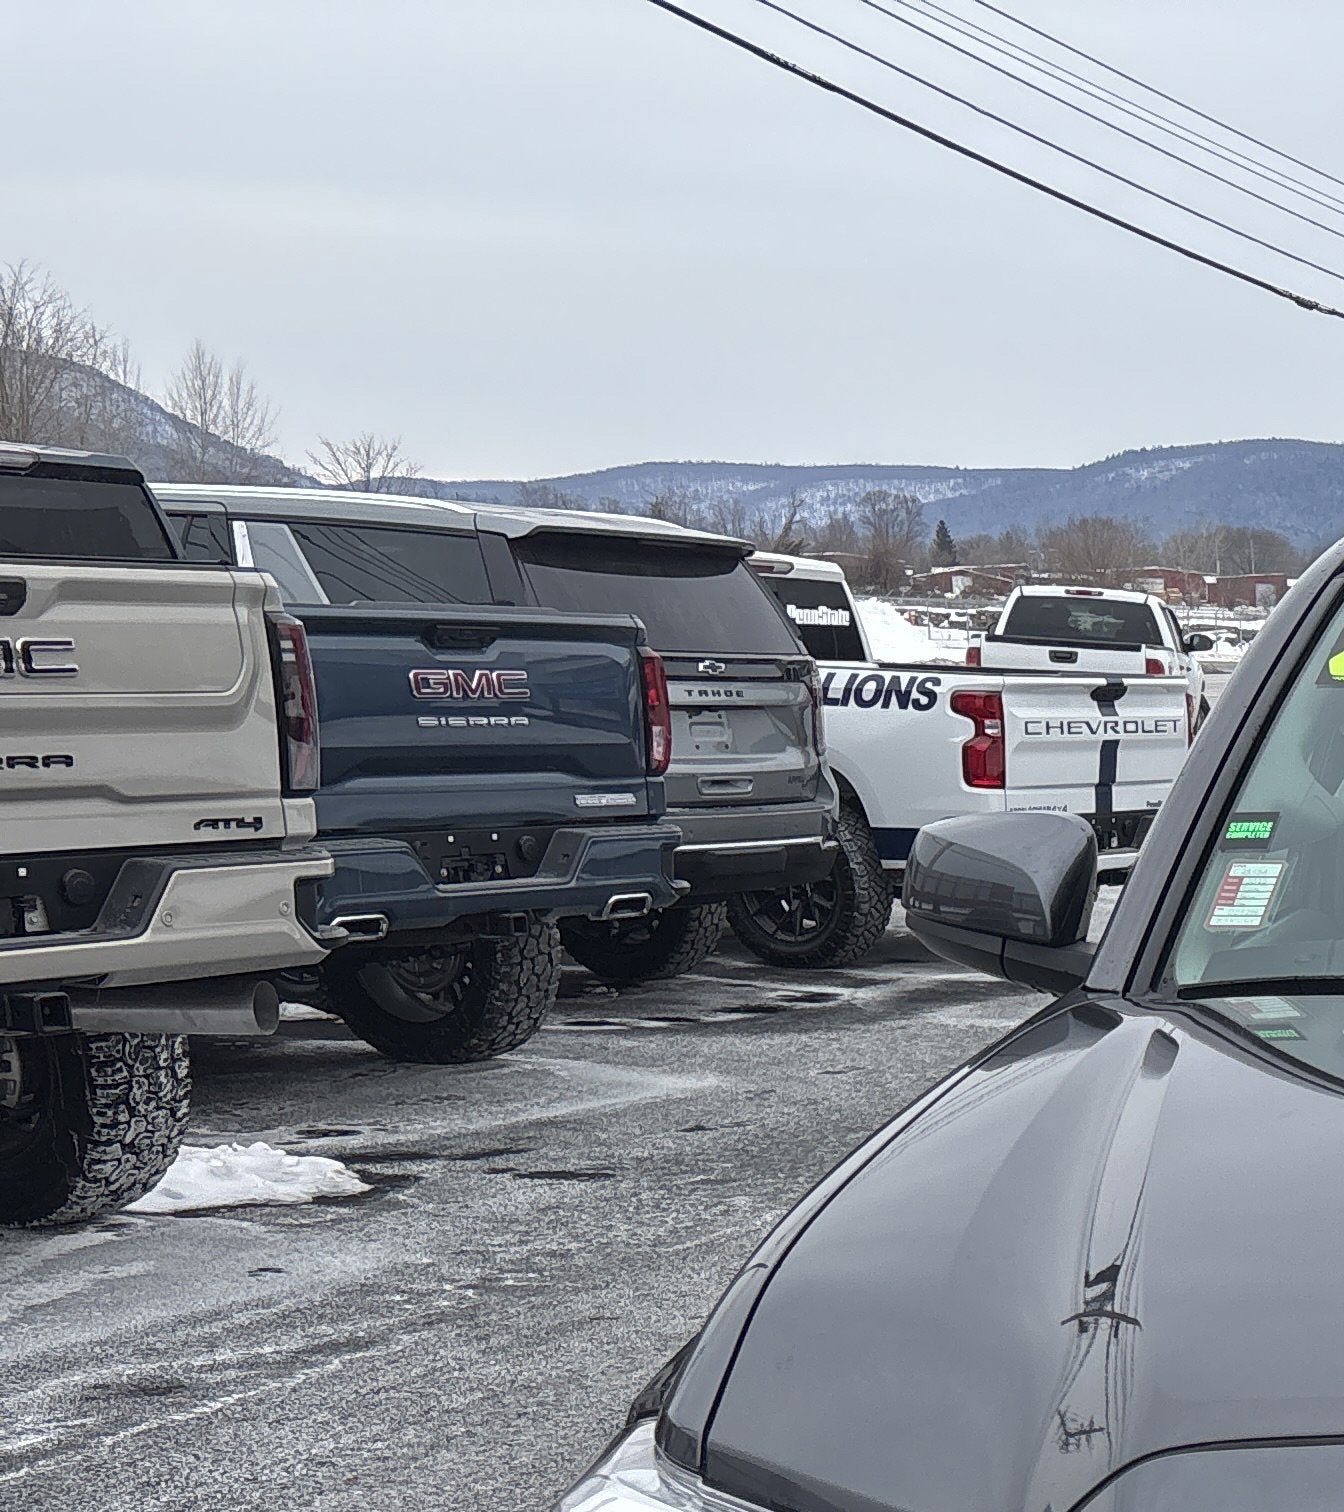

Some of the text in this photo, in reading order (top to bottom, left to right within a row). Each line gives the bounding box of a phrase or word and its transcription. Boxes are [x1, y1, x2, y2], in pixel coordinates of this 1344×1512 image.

[409, 669, 530, 698] GMC
[822, 672, 942, 711] LIONS
[684, 689, 744, 698] TAHOE
[418, 716, 529, 728] SIERRA
[1025, 718, 1181, 735] CHEVROLET
[193, 816, 263, 832] AT4
[1229, 822, 1273, 832] SERVICE
